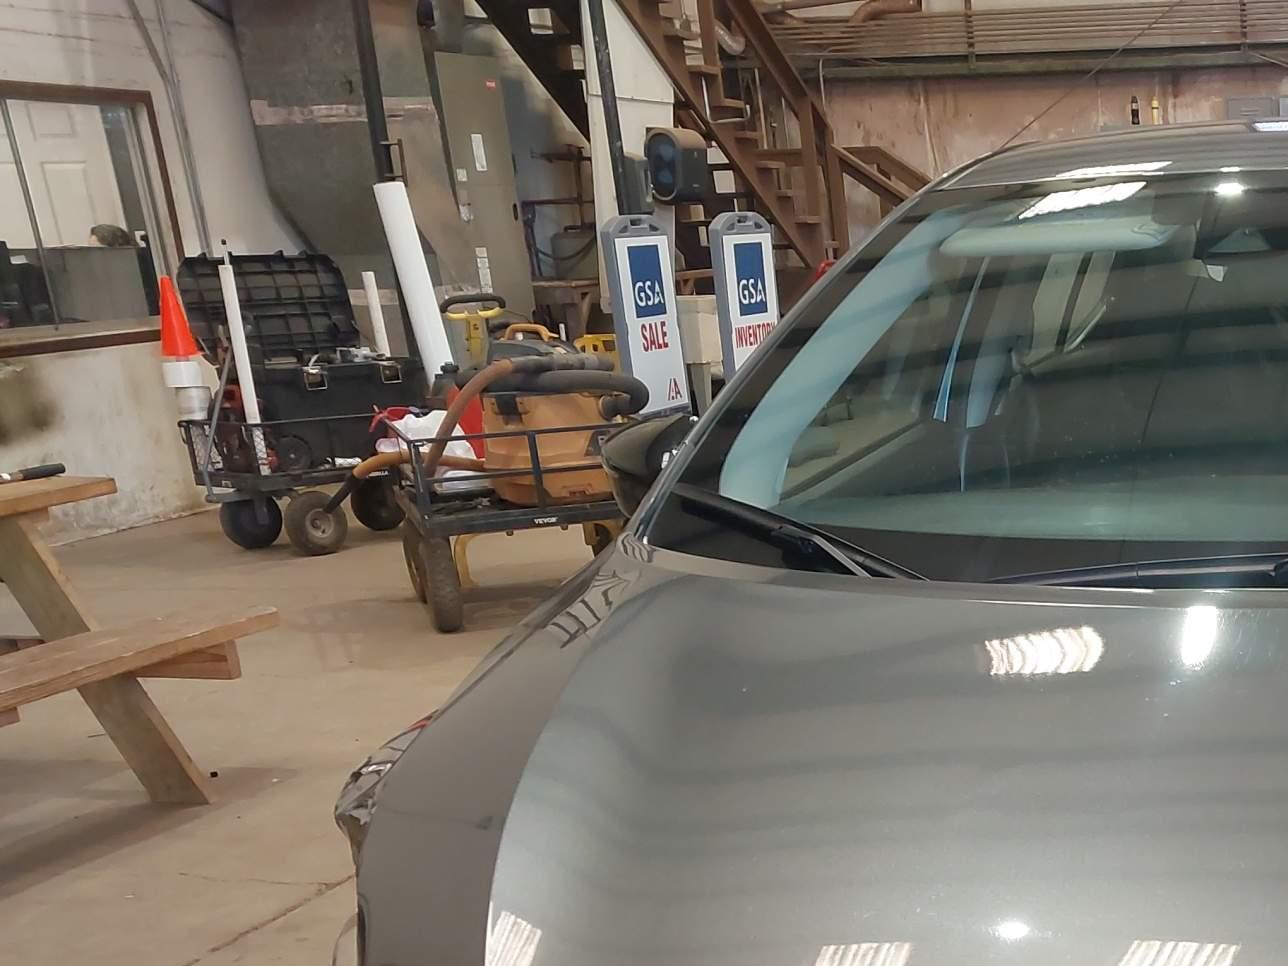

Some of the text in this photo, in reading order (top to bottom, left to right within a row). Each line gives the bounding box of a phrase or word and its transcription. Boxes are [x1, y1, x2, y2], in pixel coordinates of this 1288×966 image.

[634, 280, 664, 307] GSA
[738, 278, 766, 305] GSA
[640, 321, 669, 352] SALE
